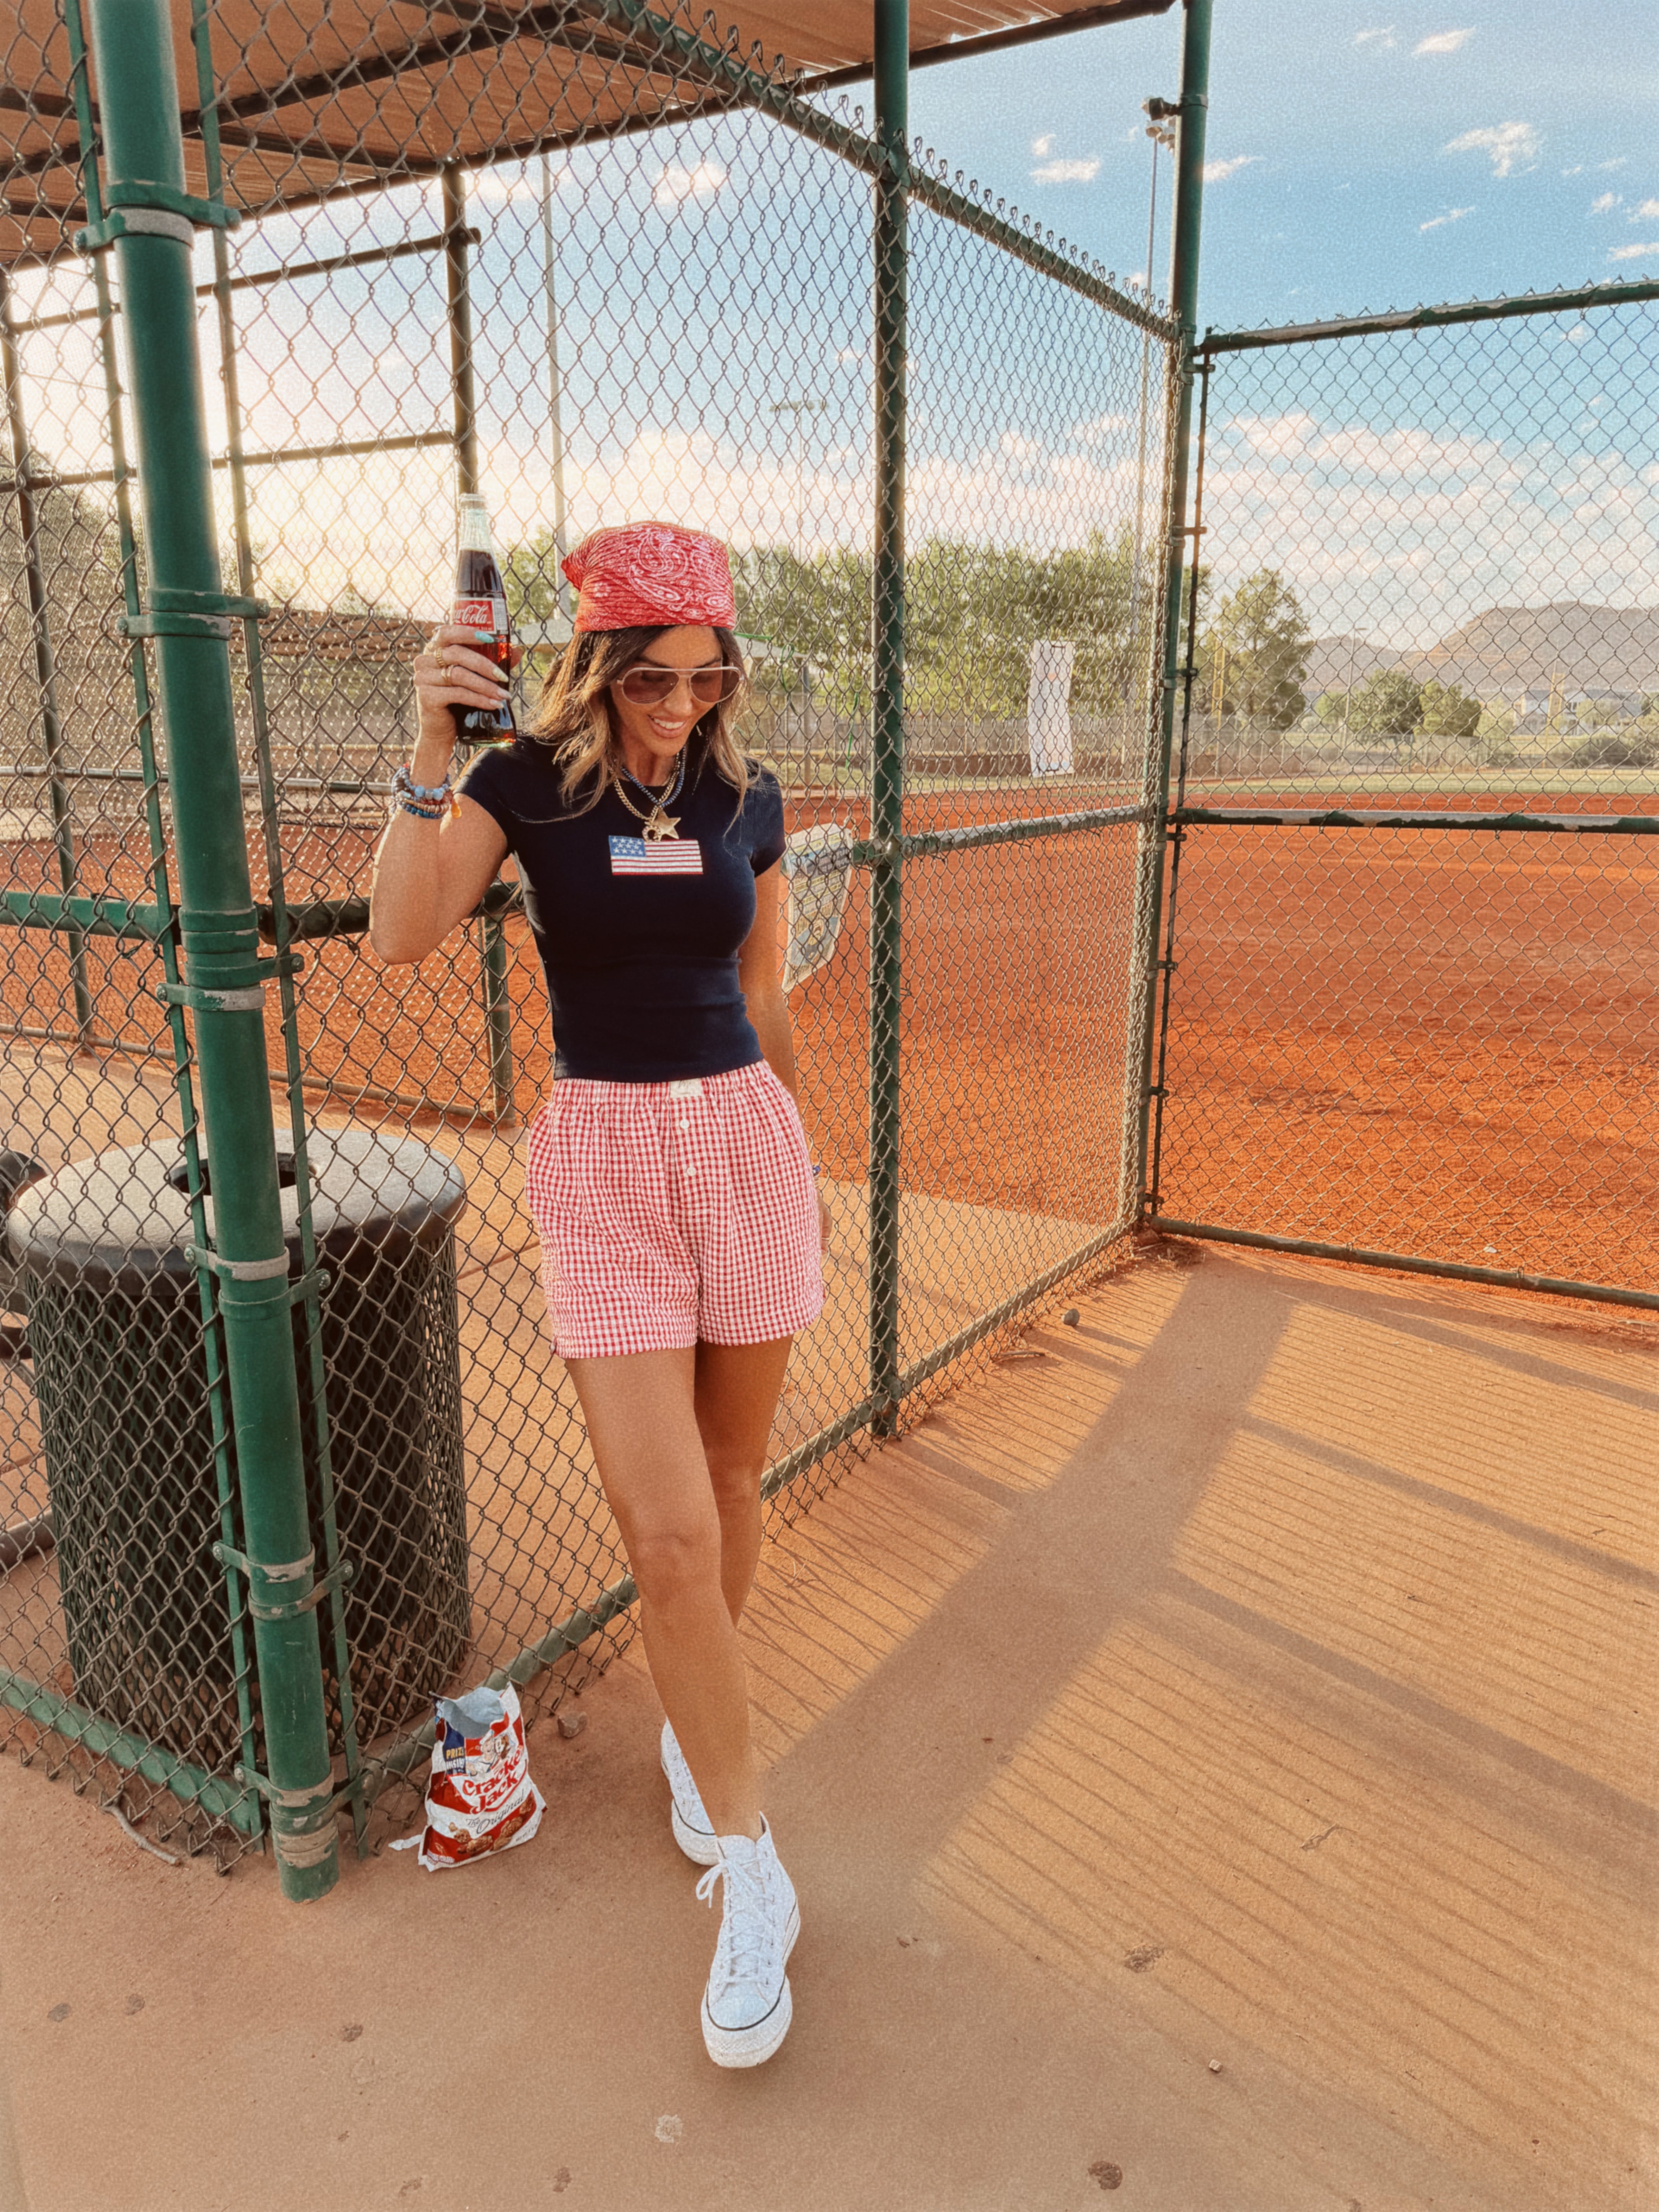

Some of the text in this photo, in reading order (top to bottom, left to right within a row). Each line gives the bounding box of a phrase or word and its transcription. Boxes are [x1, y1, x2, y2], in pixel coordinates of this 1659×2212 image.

[466, 1818, 480, 1827] The
[477, 1788, 524, 1834] Original
[470, 1771, 518, 1814] Jack
